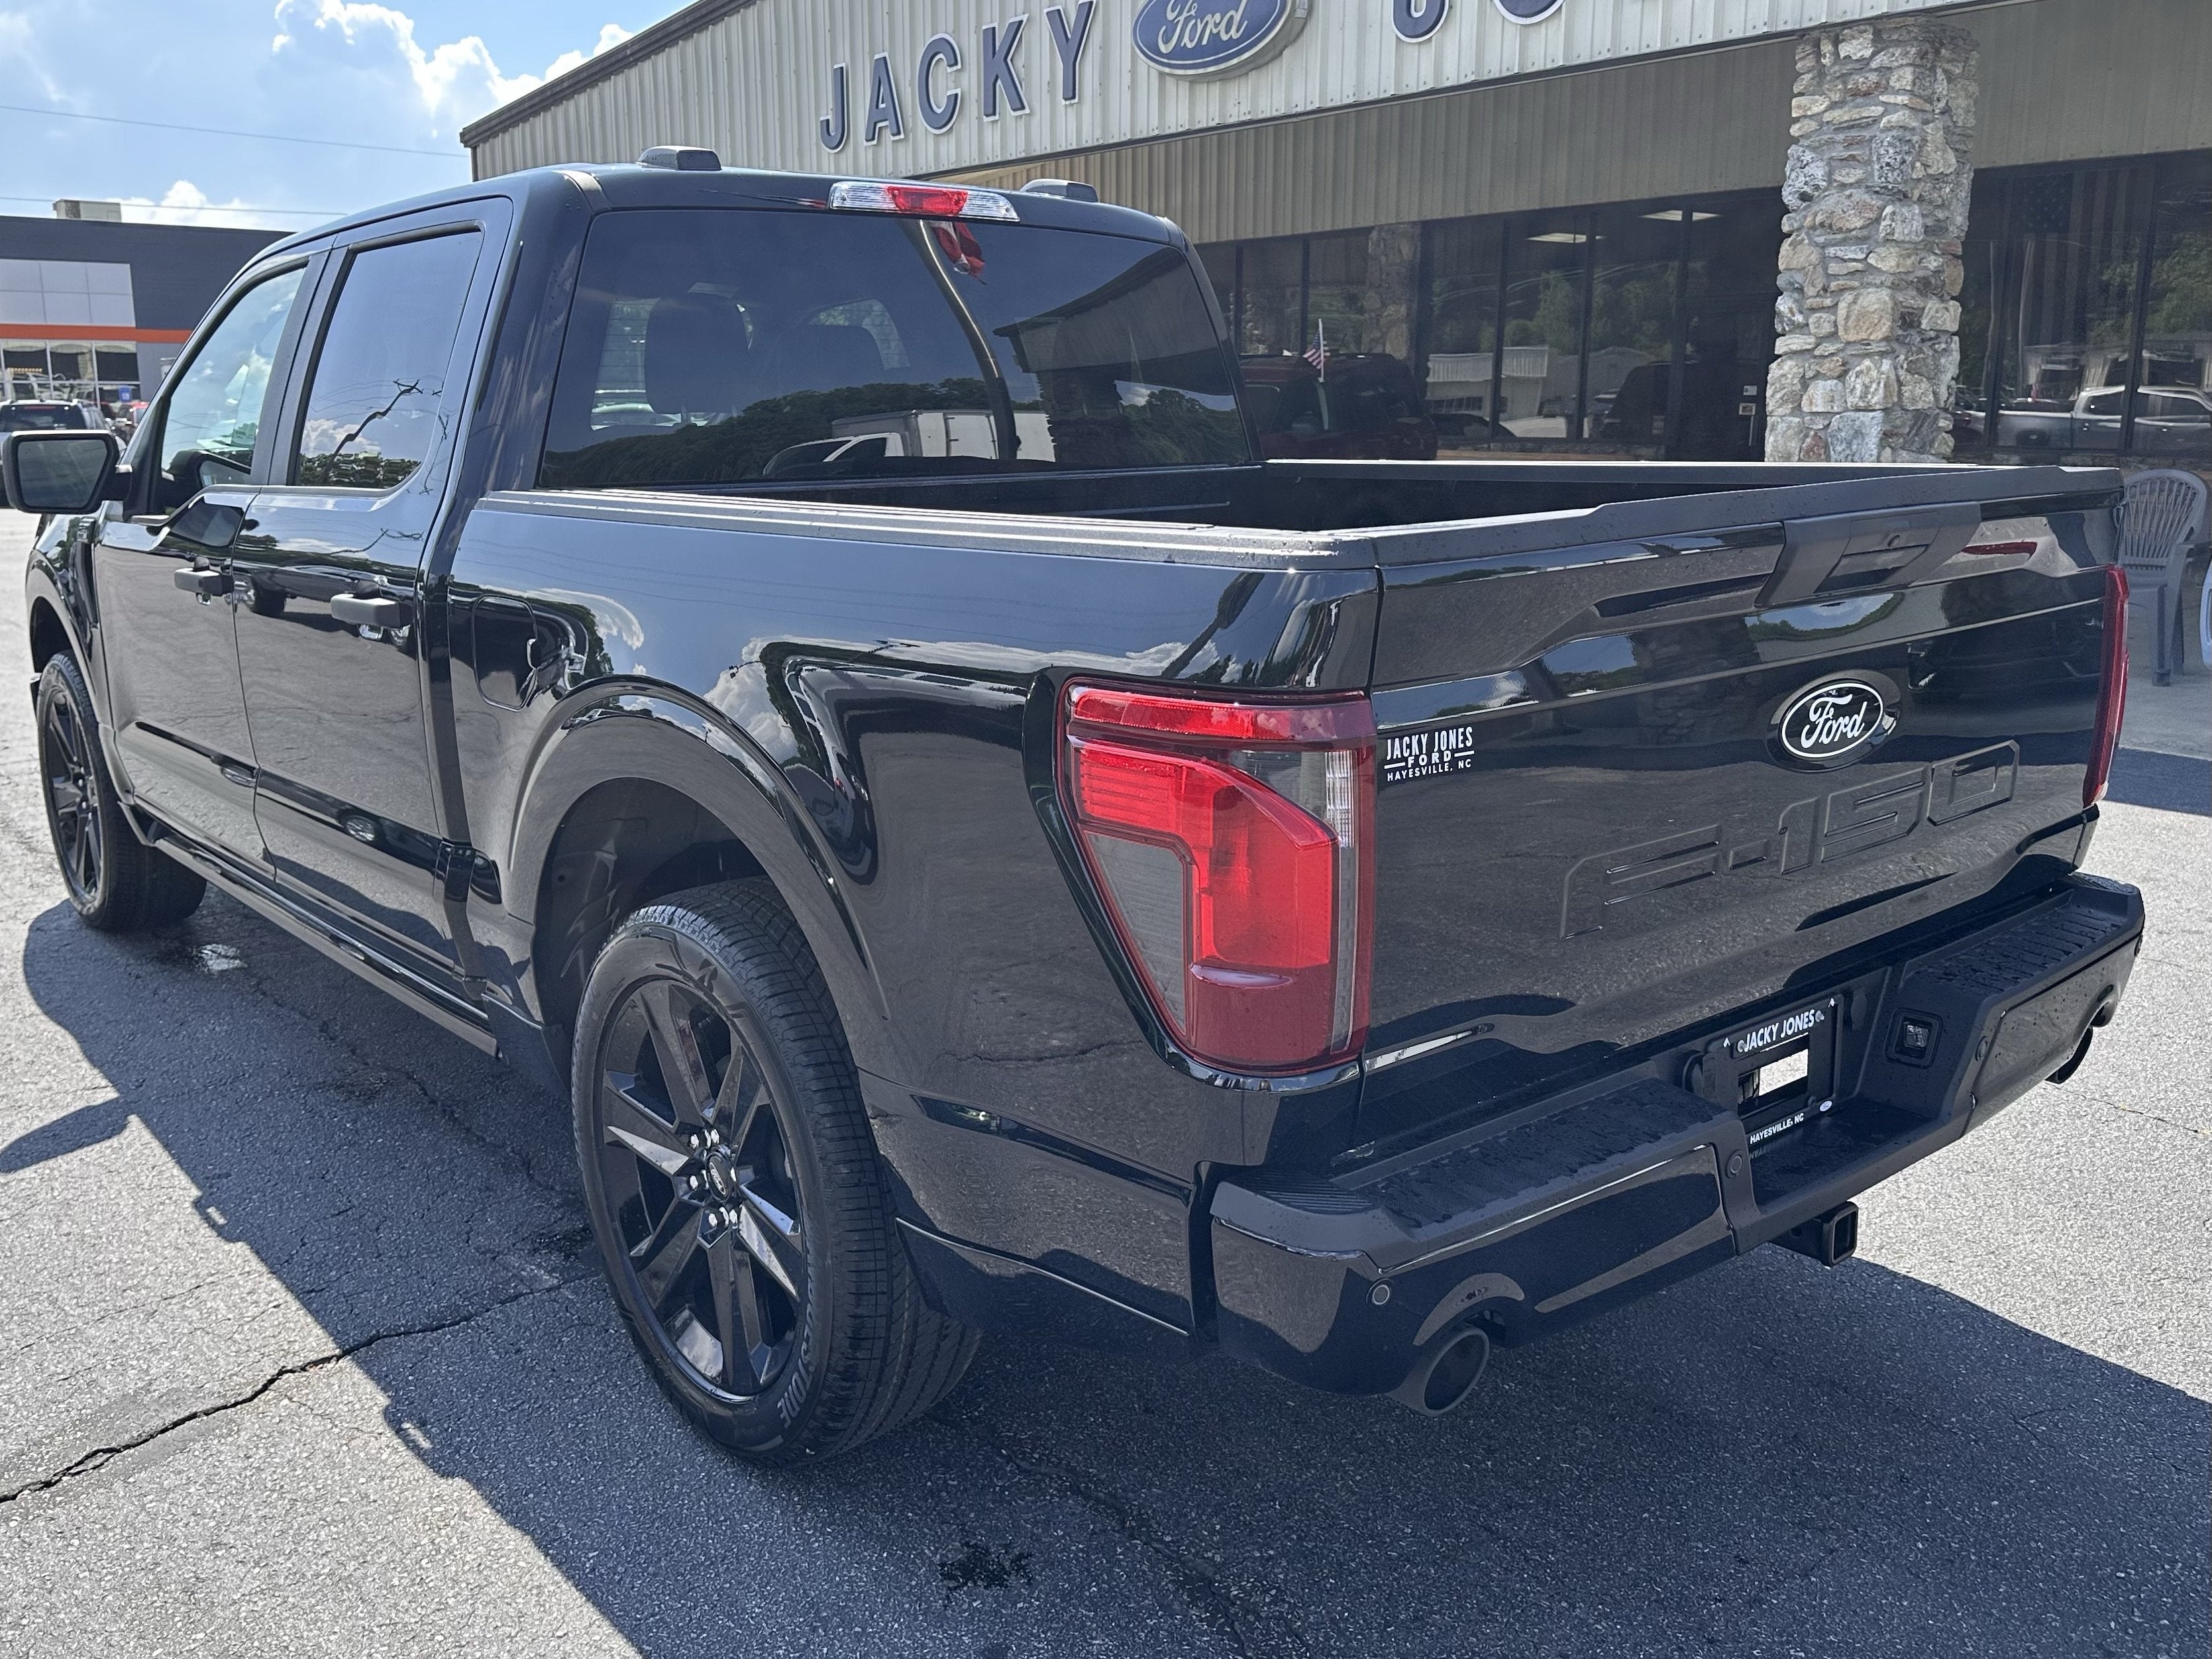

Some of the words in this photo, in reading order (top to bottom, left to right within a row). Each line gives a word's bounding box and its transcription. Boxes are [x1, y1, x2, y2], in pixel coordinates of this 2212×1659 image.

[1159, 0, 1247, 54] Ford
[820, 0, 1095, 153] JACKY
[1801, 694, 1868, 749] Ford
[1387, 733, 1428, 761] JACKY
[1434, 726, 1473, 753] JONES
[1408, 750, 1451, 768] FORD
[1387, 763, 1453, 782] HAYESVILLE,
[1458, 759, 1471, 769] NC
[1561, 739, 2019, 939] F-150
[1744, 1022, 1779, 1052] JACKY
[1781, 1009, 1815, 1038] JONES
[1750, 1117, 1793, 1145] HAYESVILLE,
[1794, 1112, 1804, 1124] NC
